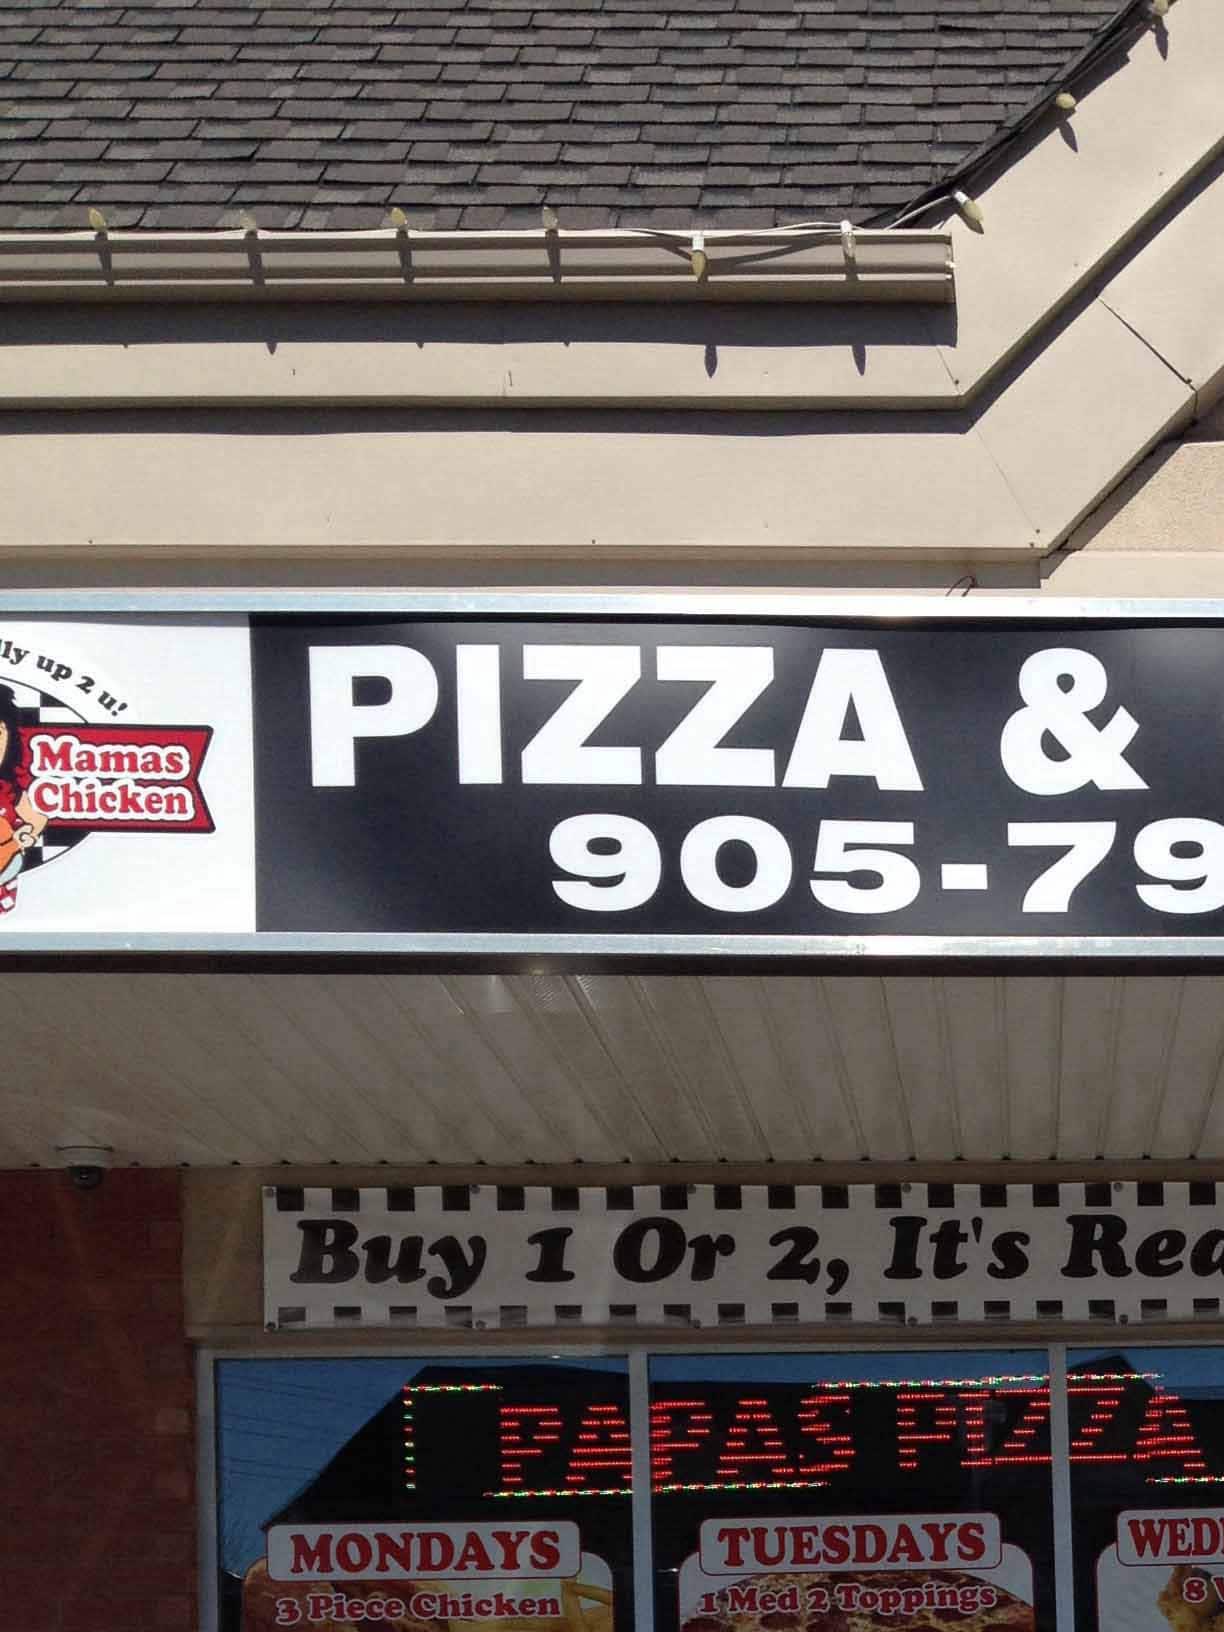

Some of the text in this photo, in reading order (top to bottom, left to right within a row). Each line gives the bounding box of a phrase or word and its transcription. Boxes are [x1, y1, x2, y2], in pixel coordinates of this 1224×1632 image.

[0, 639, 128, 716] ly up 2 u!
[308, 644, 925, 791] PIZZA
[1000, 646, 1150, 796] &
[36, 740, 185, 774] Mamas
[33, 782, 189, 815] Chicken
[290, 1218, 488, 1299] Buy
[526, 1227, 576, 1283] 1
[613, 1216, 736, 1283] Or
[767, 1227, 851, 1296] 2,
[883, 1215, 1031, 1280] It's
[500, 1386, 1206, 1482] PAPAS PIZZA
[290, 1530, 561, 1574] MONDAYS
[717, 1522, 987, 1567] TUESDAYS
[276, 1592, 561, 1624] 3 Piece Chicken
[700, 1583, 997, 1615] 1 Med 2 Toppings
[1184, 1577, 1207, 1602] 8
